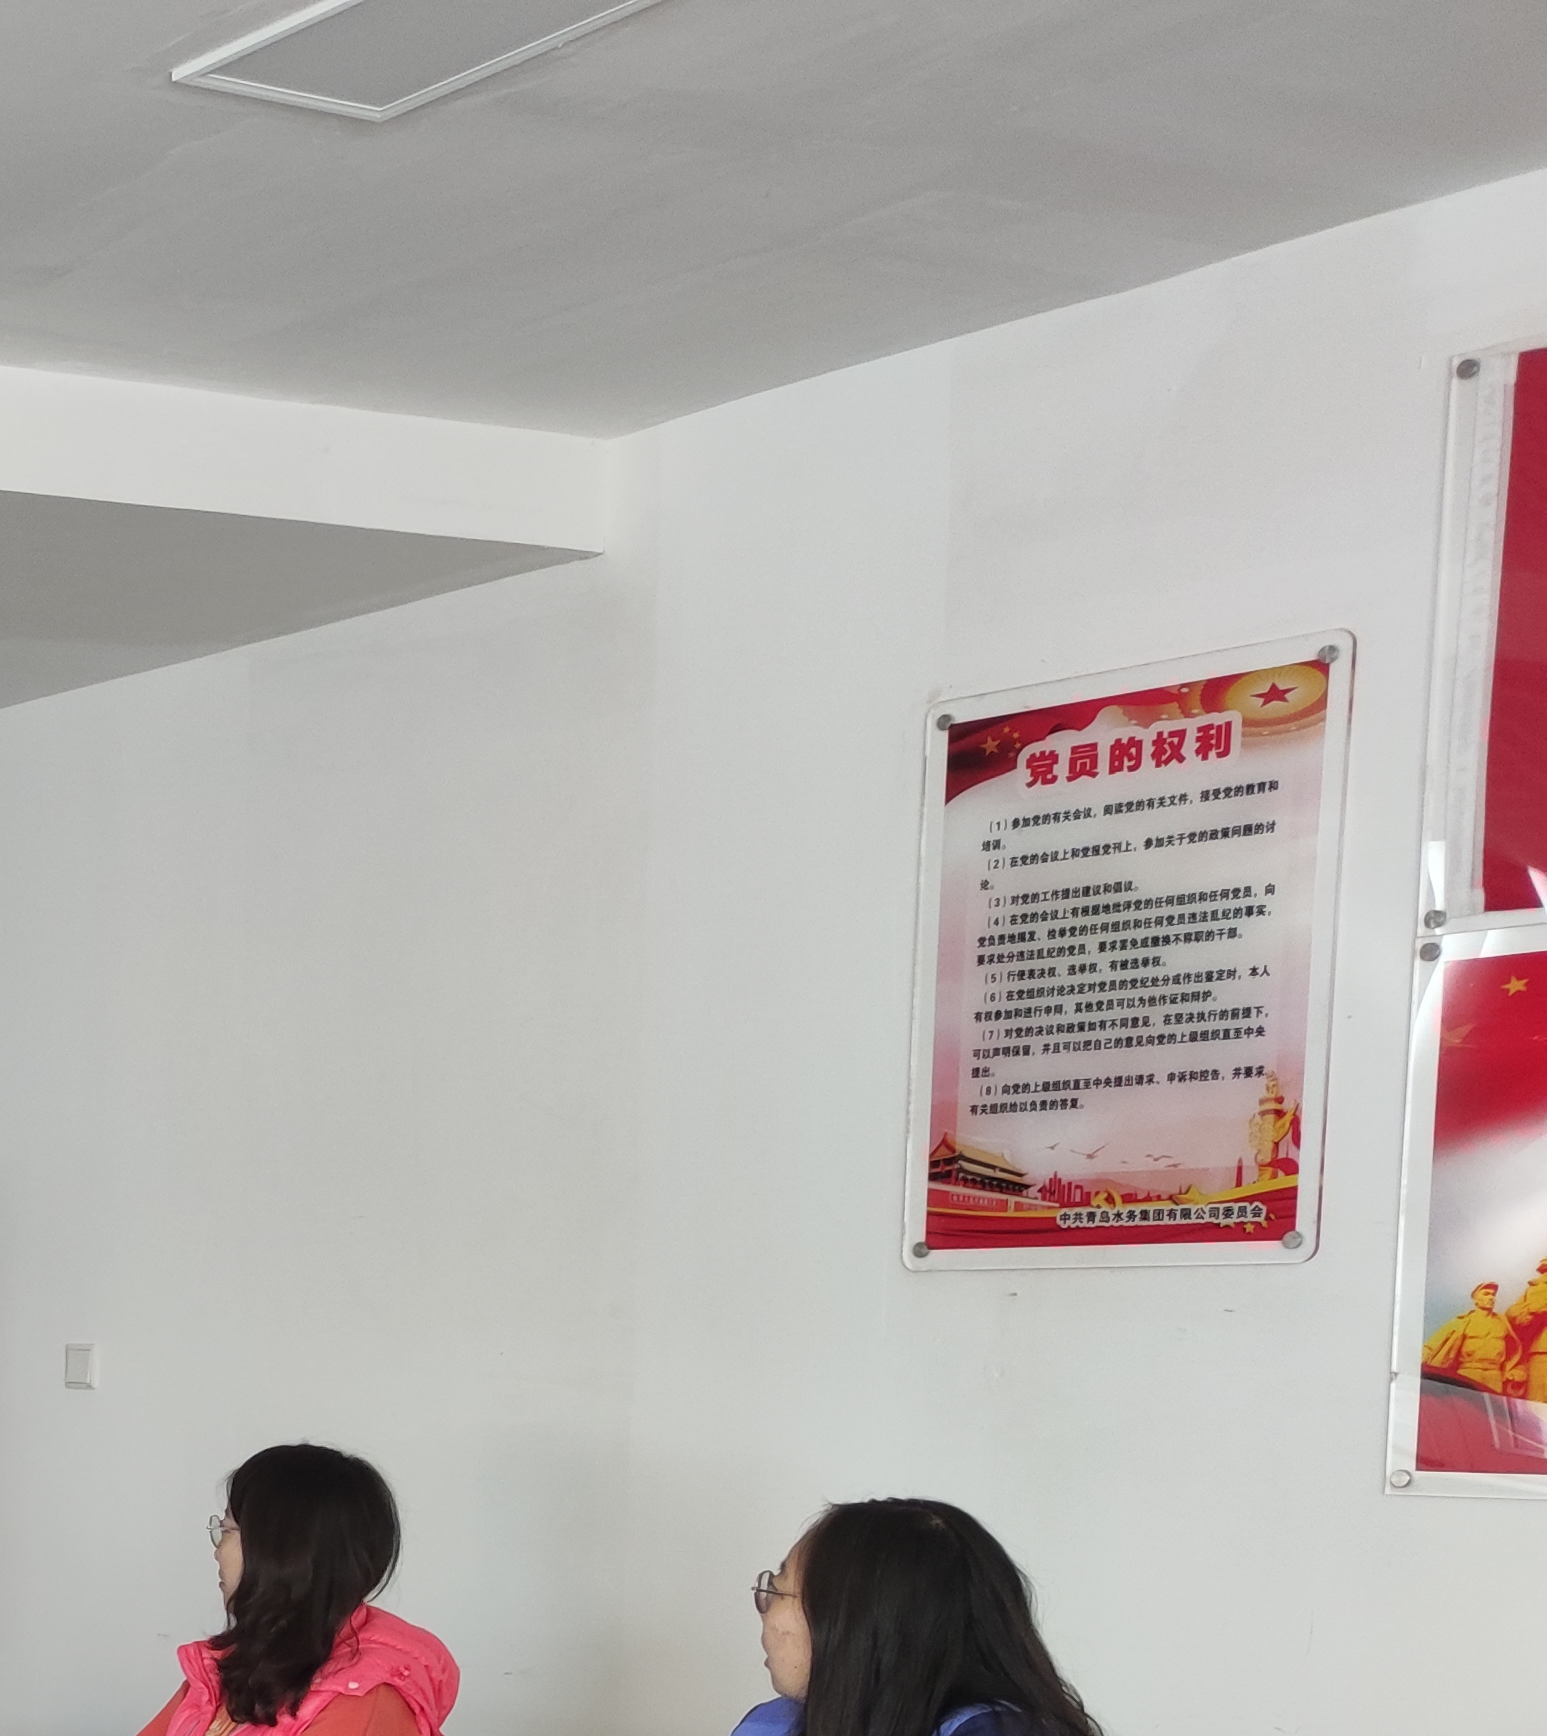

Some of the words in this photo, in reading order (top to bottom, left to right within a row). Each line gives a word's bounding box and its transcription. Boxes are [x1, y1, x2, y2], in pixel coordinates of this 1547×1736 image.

[1025, 721, 1233, 788] 党员的权利
[981, 838, 1007, 852] 培训。
[971, 1066, 996, 1079] 提出。
[1059, 1202, 1264, 1225] 中共青岛水务集团有限公司委员会
